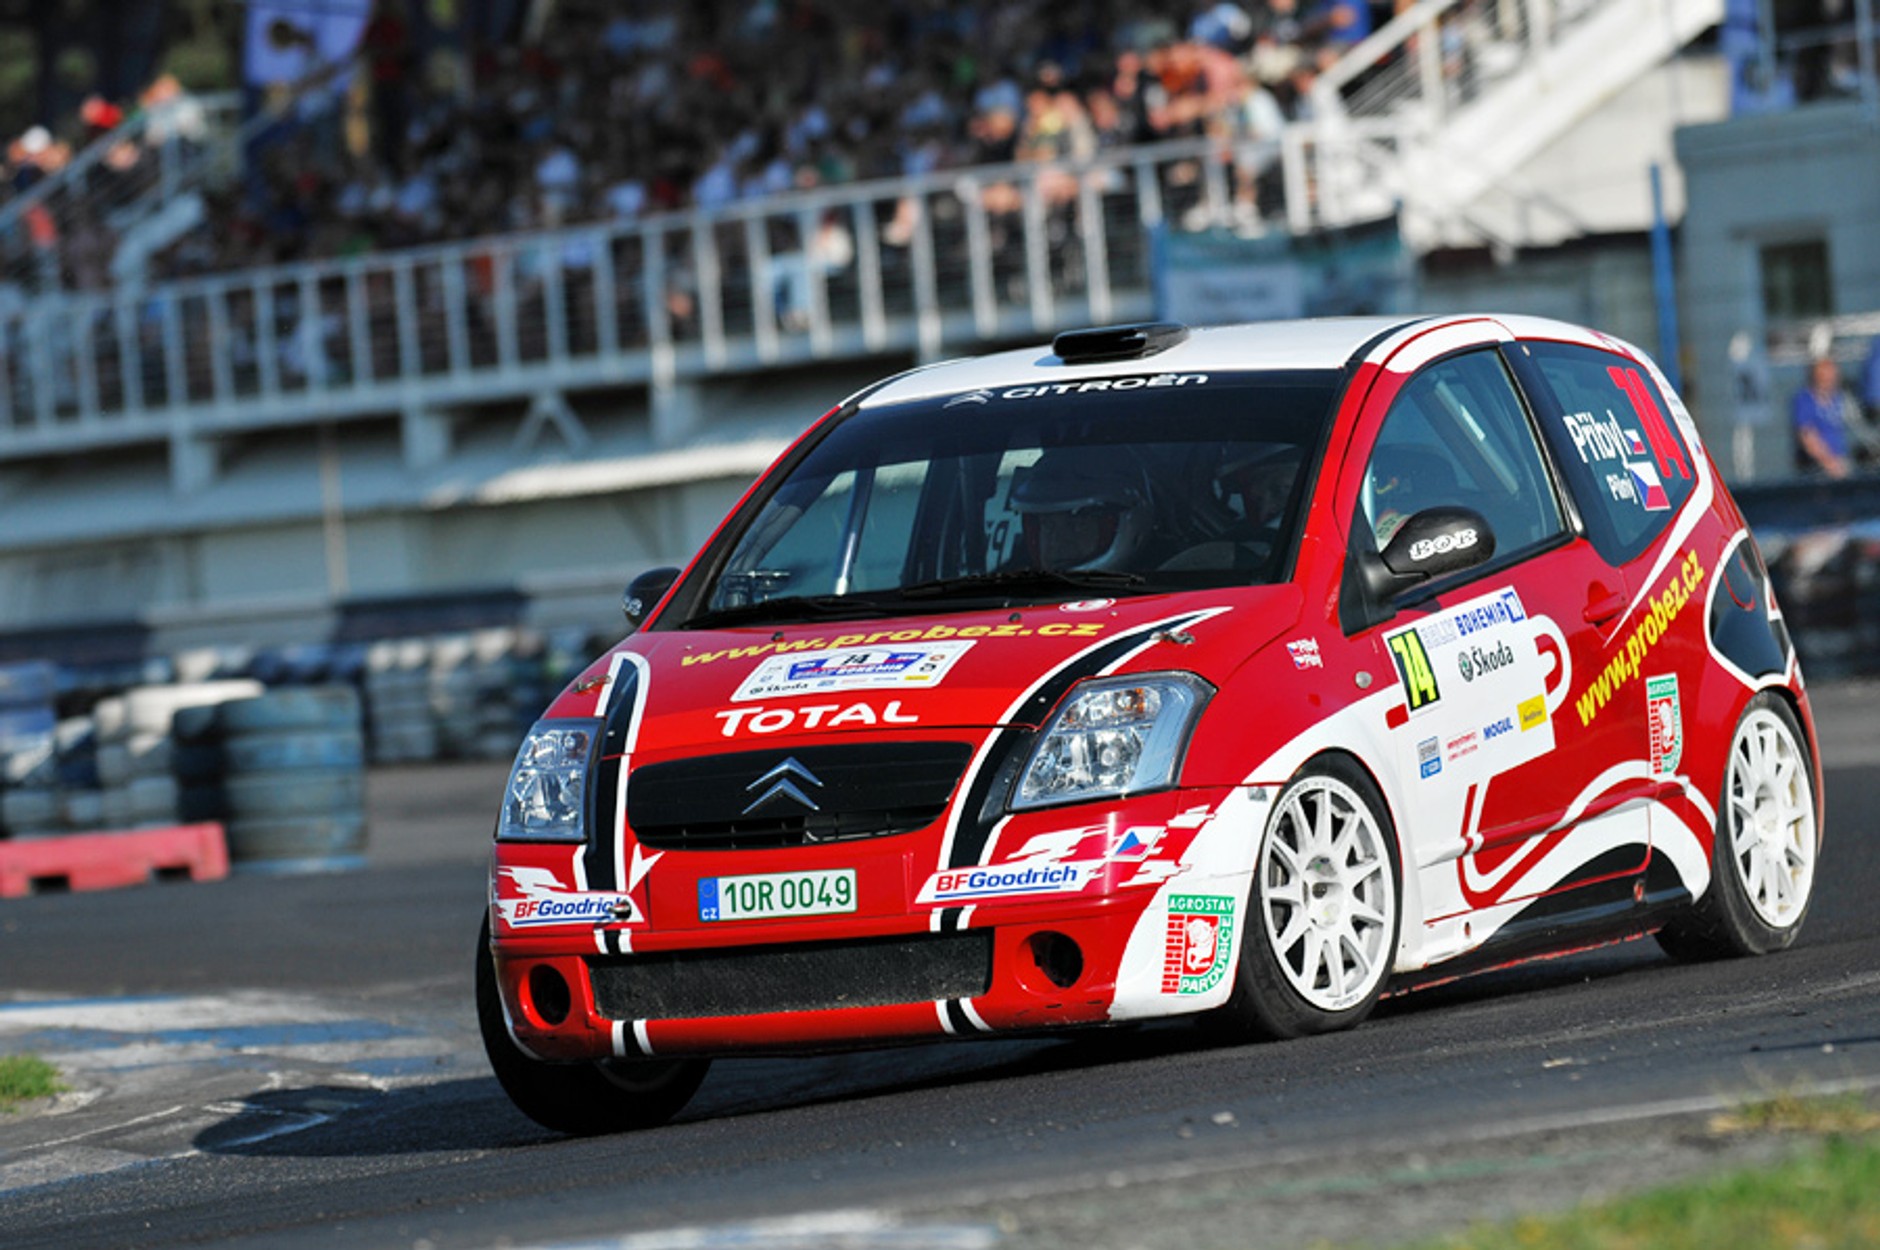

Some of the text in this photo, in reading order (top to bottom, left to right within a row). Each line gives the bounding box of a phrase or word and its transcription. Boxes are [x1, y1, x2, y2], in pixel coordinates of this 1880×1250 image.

[681, 622, 1106, 667] www.probez.cz
[1575, 549, 1706, 727] www.probez.cz
[1470, 640, 1515, 677] Škoda
[714, 701, 920, 737] TOTAL
[724, 875, 853, 914] 10R 0049
[935, 864, 1079, 892] BFGoodrich
[701, 907, 720, 920] CZ
[1167, 897, 1235, 911] AGROSTAV
